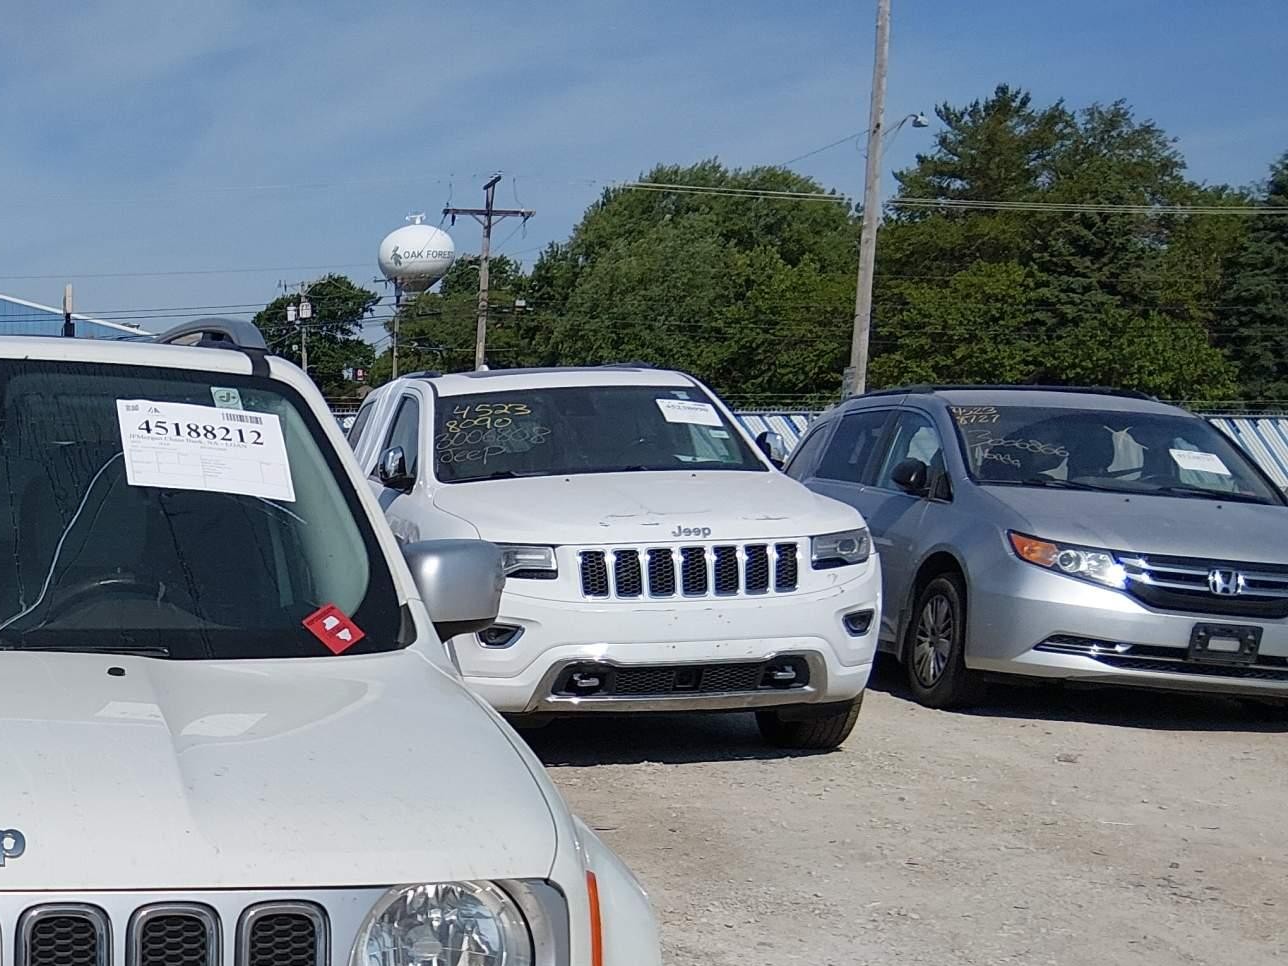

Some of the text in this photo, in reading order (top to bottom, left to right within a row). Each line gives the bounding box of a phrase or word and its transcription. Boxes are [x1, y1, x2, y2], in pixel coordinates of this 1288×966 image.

[403, 251, 423, 259] OAK
[453, 403, 531, 418] 4523
[138, 419, 264, 446] 45188212
[446, 417, 512, 433] 8090
[671, 525, 712, 539] Jeep
